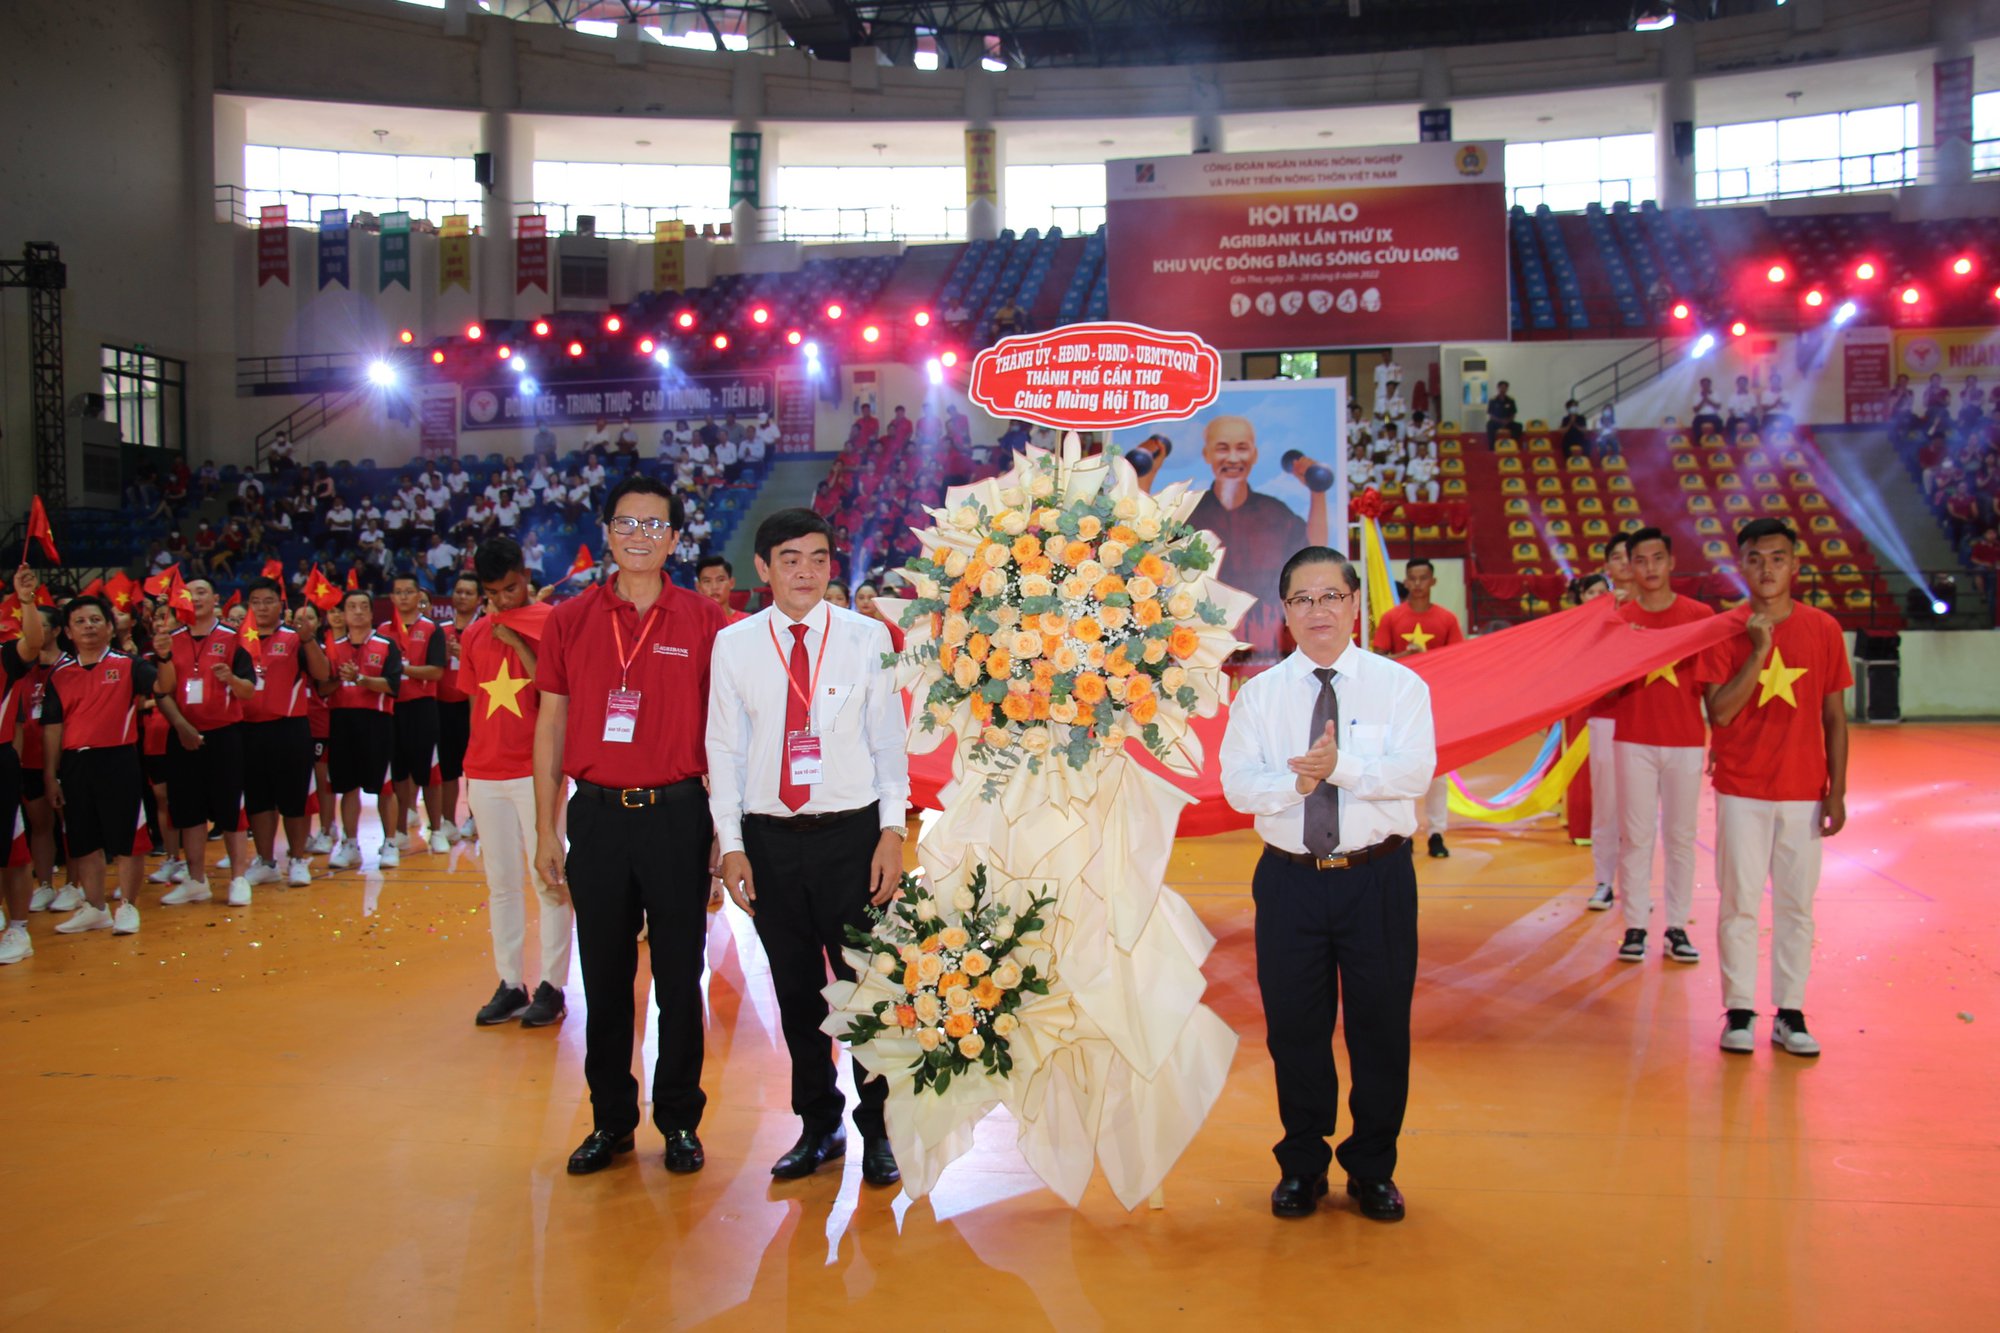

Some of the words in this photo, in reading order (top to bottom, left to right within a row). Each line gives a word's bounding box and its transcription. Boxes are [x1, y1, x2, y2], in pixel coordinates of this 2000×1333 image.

[1203, 161, 1232, 173] CÔNG
[1235, 160, 1265, 171] ĐOÀN
[1267, 158, 1296, 170] NGÂN
[1299, 158, 1329, 168] HÀNG
[1331, 156, 1362, 166] NÔNG
[1209, 177, 1222, 187] VÀ
[1284, 173, 1314, 184] NÔNG
[1317, 171, 1345, 182] THÔN
[1373, 169, 1397, 179] NAM
[1248, 205, 1289, 227] HỘI
[1294, 202, 1359, 223] THAO
[1219, 232, 1301, 249] AGRIBANK
[1339, 227, 1374, 244] THỨ
[1376, 228, 1393, 243] IX
[1153, 258, 1187, 274] KHU
[1189, 256, 1223, 275] VỰC
[1326, 249, 1372, 266] SÔNG
[1374, 245, 1410, 263] CỬU
[1413, 246, 1459, 262] LONG
[994, 348, 1034, 374] THÀNH
[1035, 342, 1052, 367] ỦY
[1057, 344, 1090, 363] HĐND
[1097, 343, 1129, 362] UBND
[1136, 345, 1199, 373] UBMTTQVN
[1026, 366, 1069, 386] THÀNH
[1072, 364, 1102, 386] PHỐ
[1103, 363, 1132, 386] CẦN
[1135, 369, 1163, 386] THƠ
[536, 388, 556, 416] KẾT
[566, 393, 602, 415] TRUNG
[604, 389, 633, 417] THỰC
[642, 390, 664, 411] CAO
[721, 381, 746, 408] TIẾN
[748, 382, 765, 411] BỘ
[1014, 388, 1053, 409] Chúc
[1055, 388, 1099, 412] Mừng
[1102, 389, 1129, 414] Hội
[1132, 390, 1169, 410] Thao
[314, 743, 323, 756] 9
